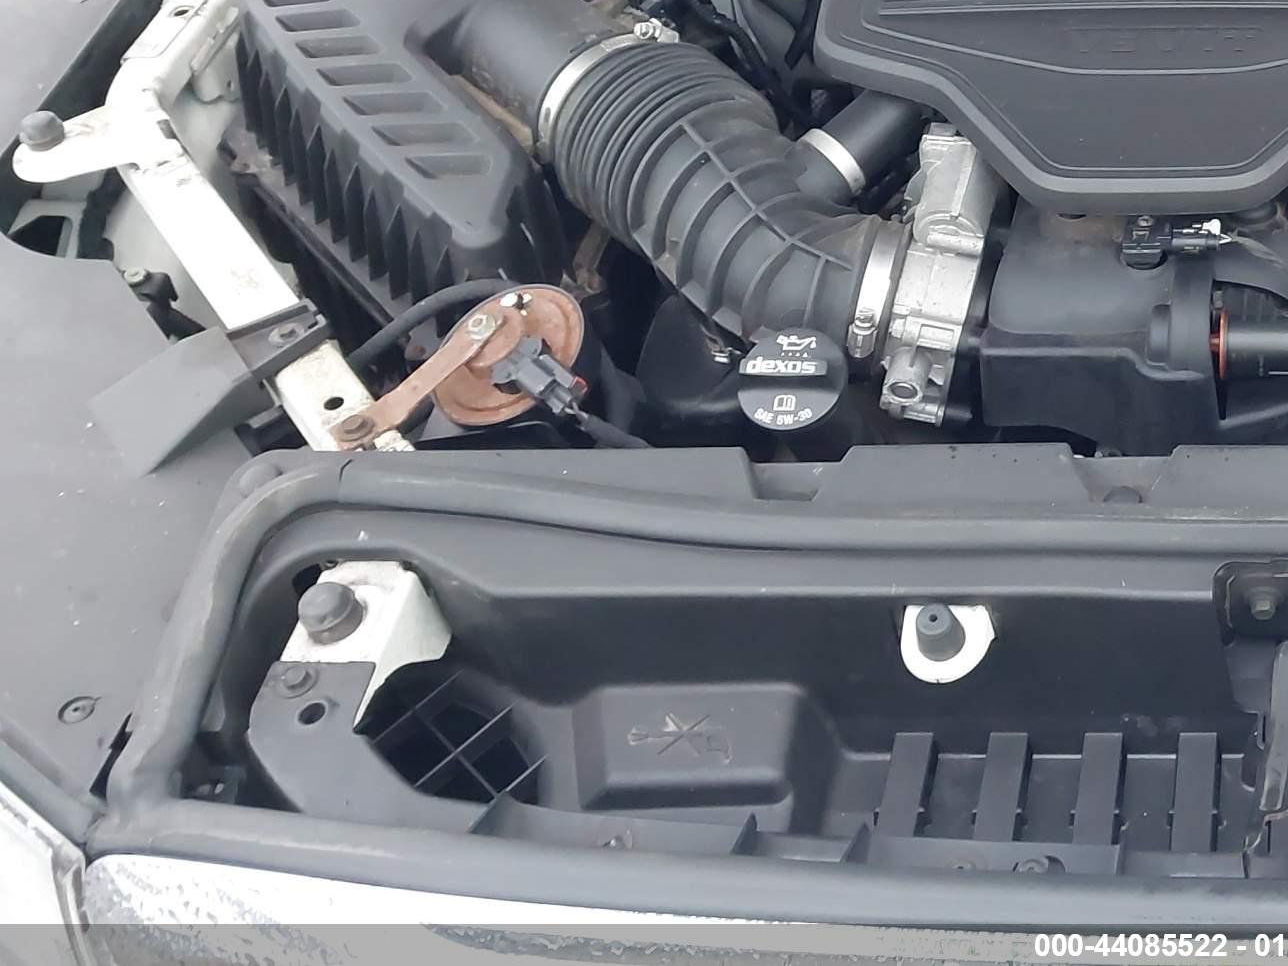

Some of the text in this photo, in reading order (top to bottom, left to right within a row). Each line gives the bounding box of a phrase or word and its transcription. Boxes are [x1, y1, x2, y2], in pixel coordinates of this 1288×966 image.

[746, 356, 818, 374] dexos
[754, 408, 813, 426] SAE 5W-30
